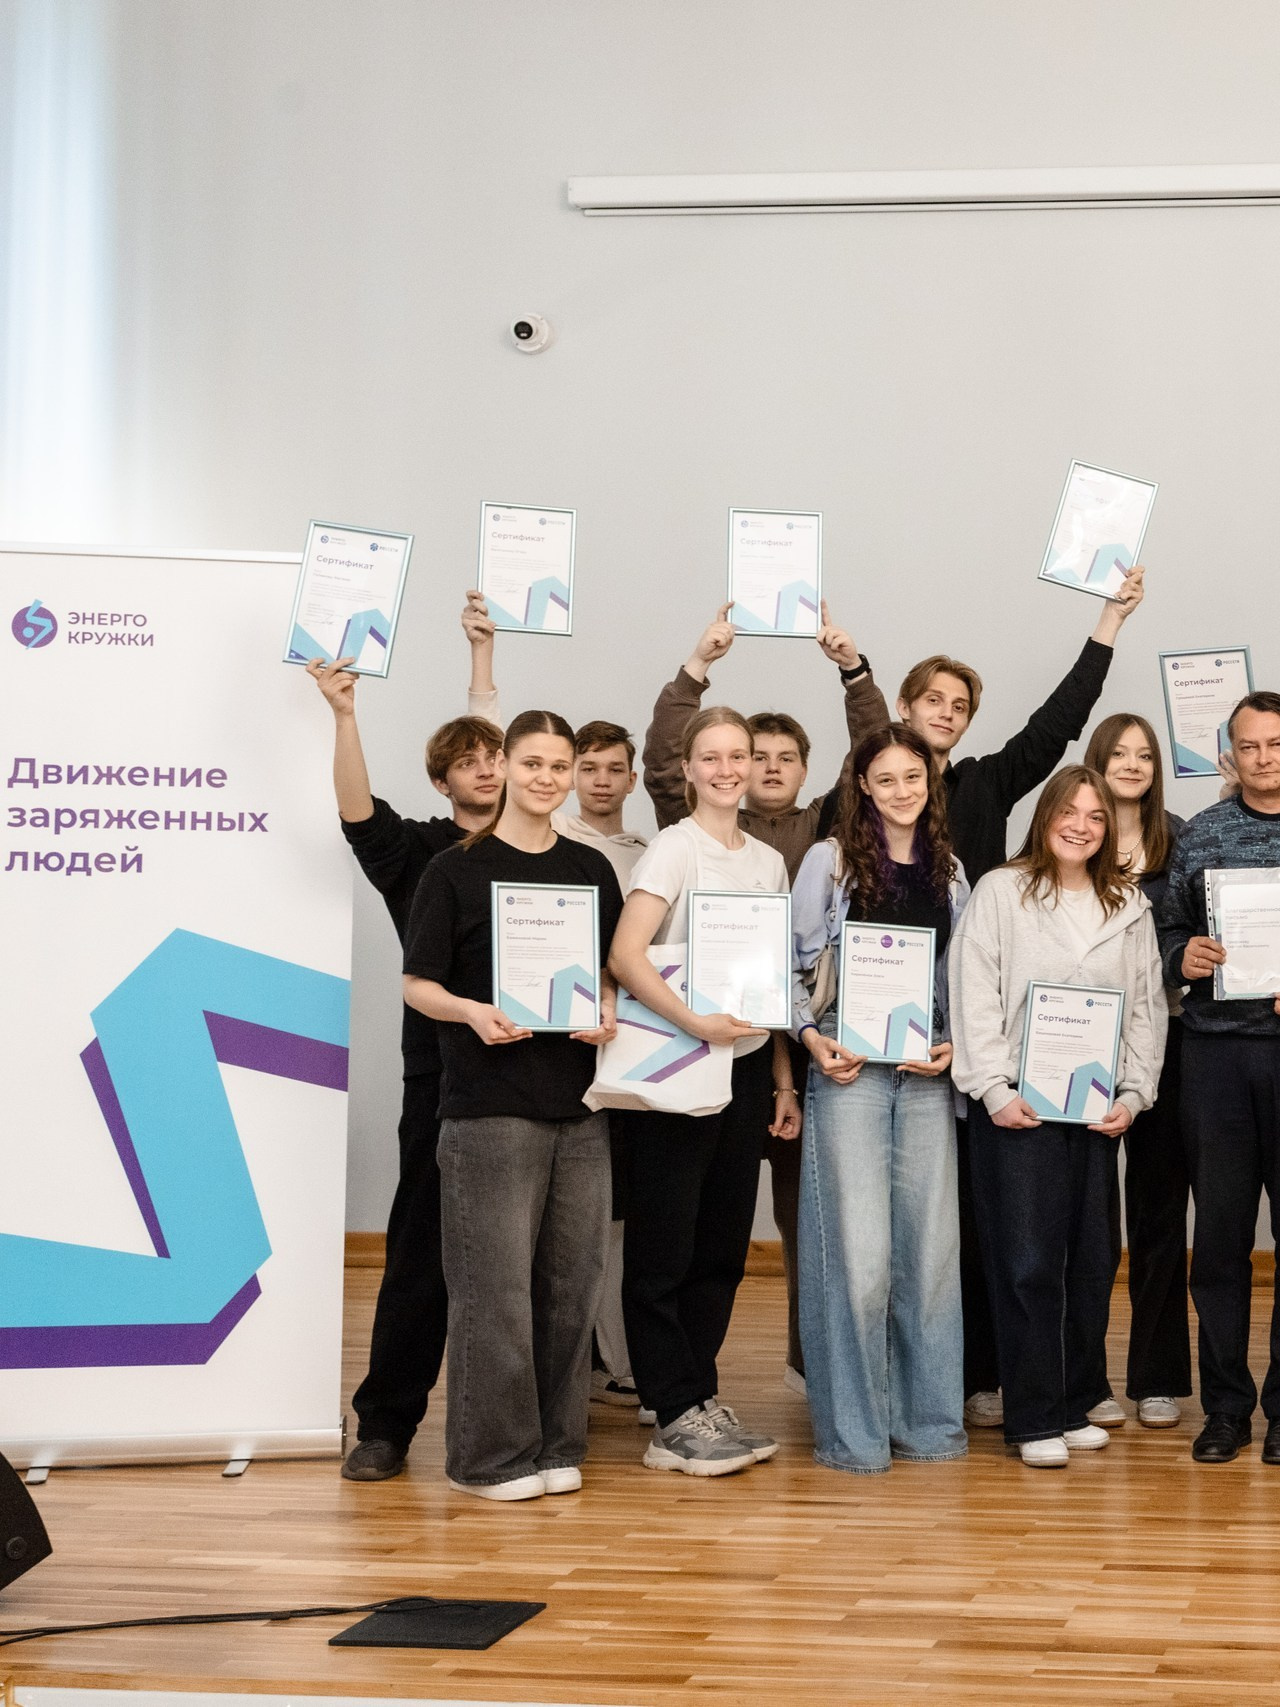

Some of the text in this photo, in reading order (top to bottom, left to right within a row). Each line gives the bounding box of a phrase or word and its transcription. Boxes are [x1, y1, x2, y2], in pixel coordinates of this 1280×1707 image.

[491, 531, 546, 543] Сертификат
[740, 537, 793, 547] Сертификат
[316, 555, 374, 570] Сертификат
[67, 611, 148, 627] ЭНЕРГО
[67, 631, 154, 647] КРУЖКИ
[1174, 677, 1224, 688] Сертификат
[7, 757, 228, 789] Движение
[6, 806, 269, 835] заряженных
[5, 845, 144, 877] людей
[506, 916, 566, 927] Сертификат
[701, 922, 759, 931] Сертификат
[851, 954, 905, 966] Сертификат
[1037, 1013, 1092, 1025] Сертификат
